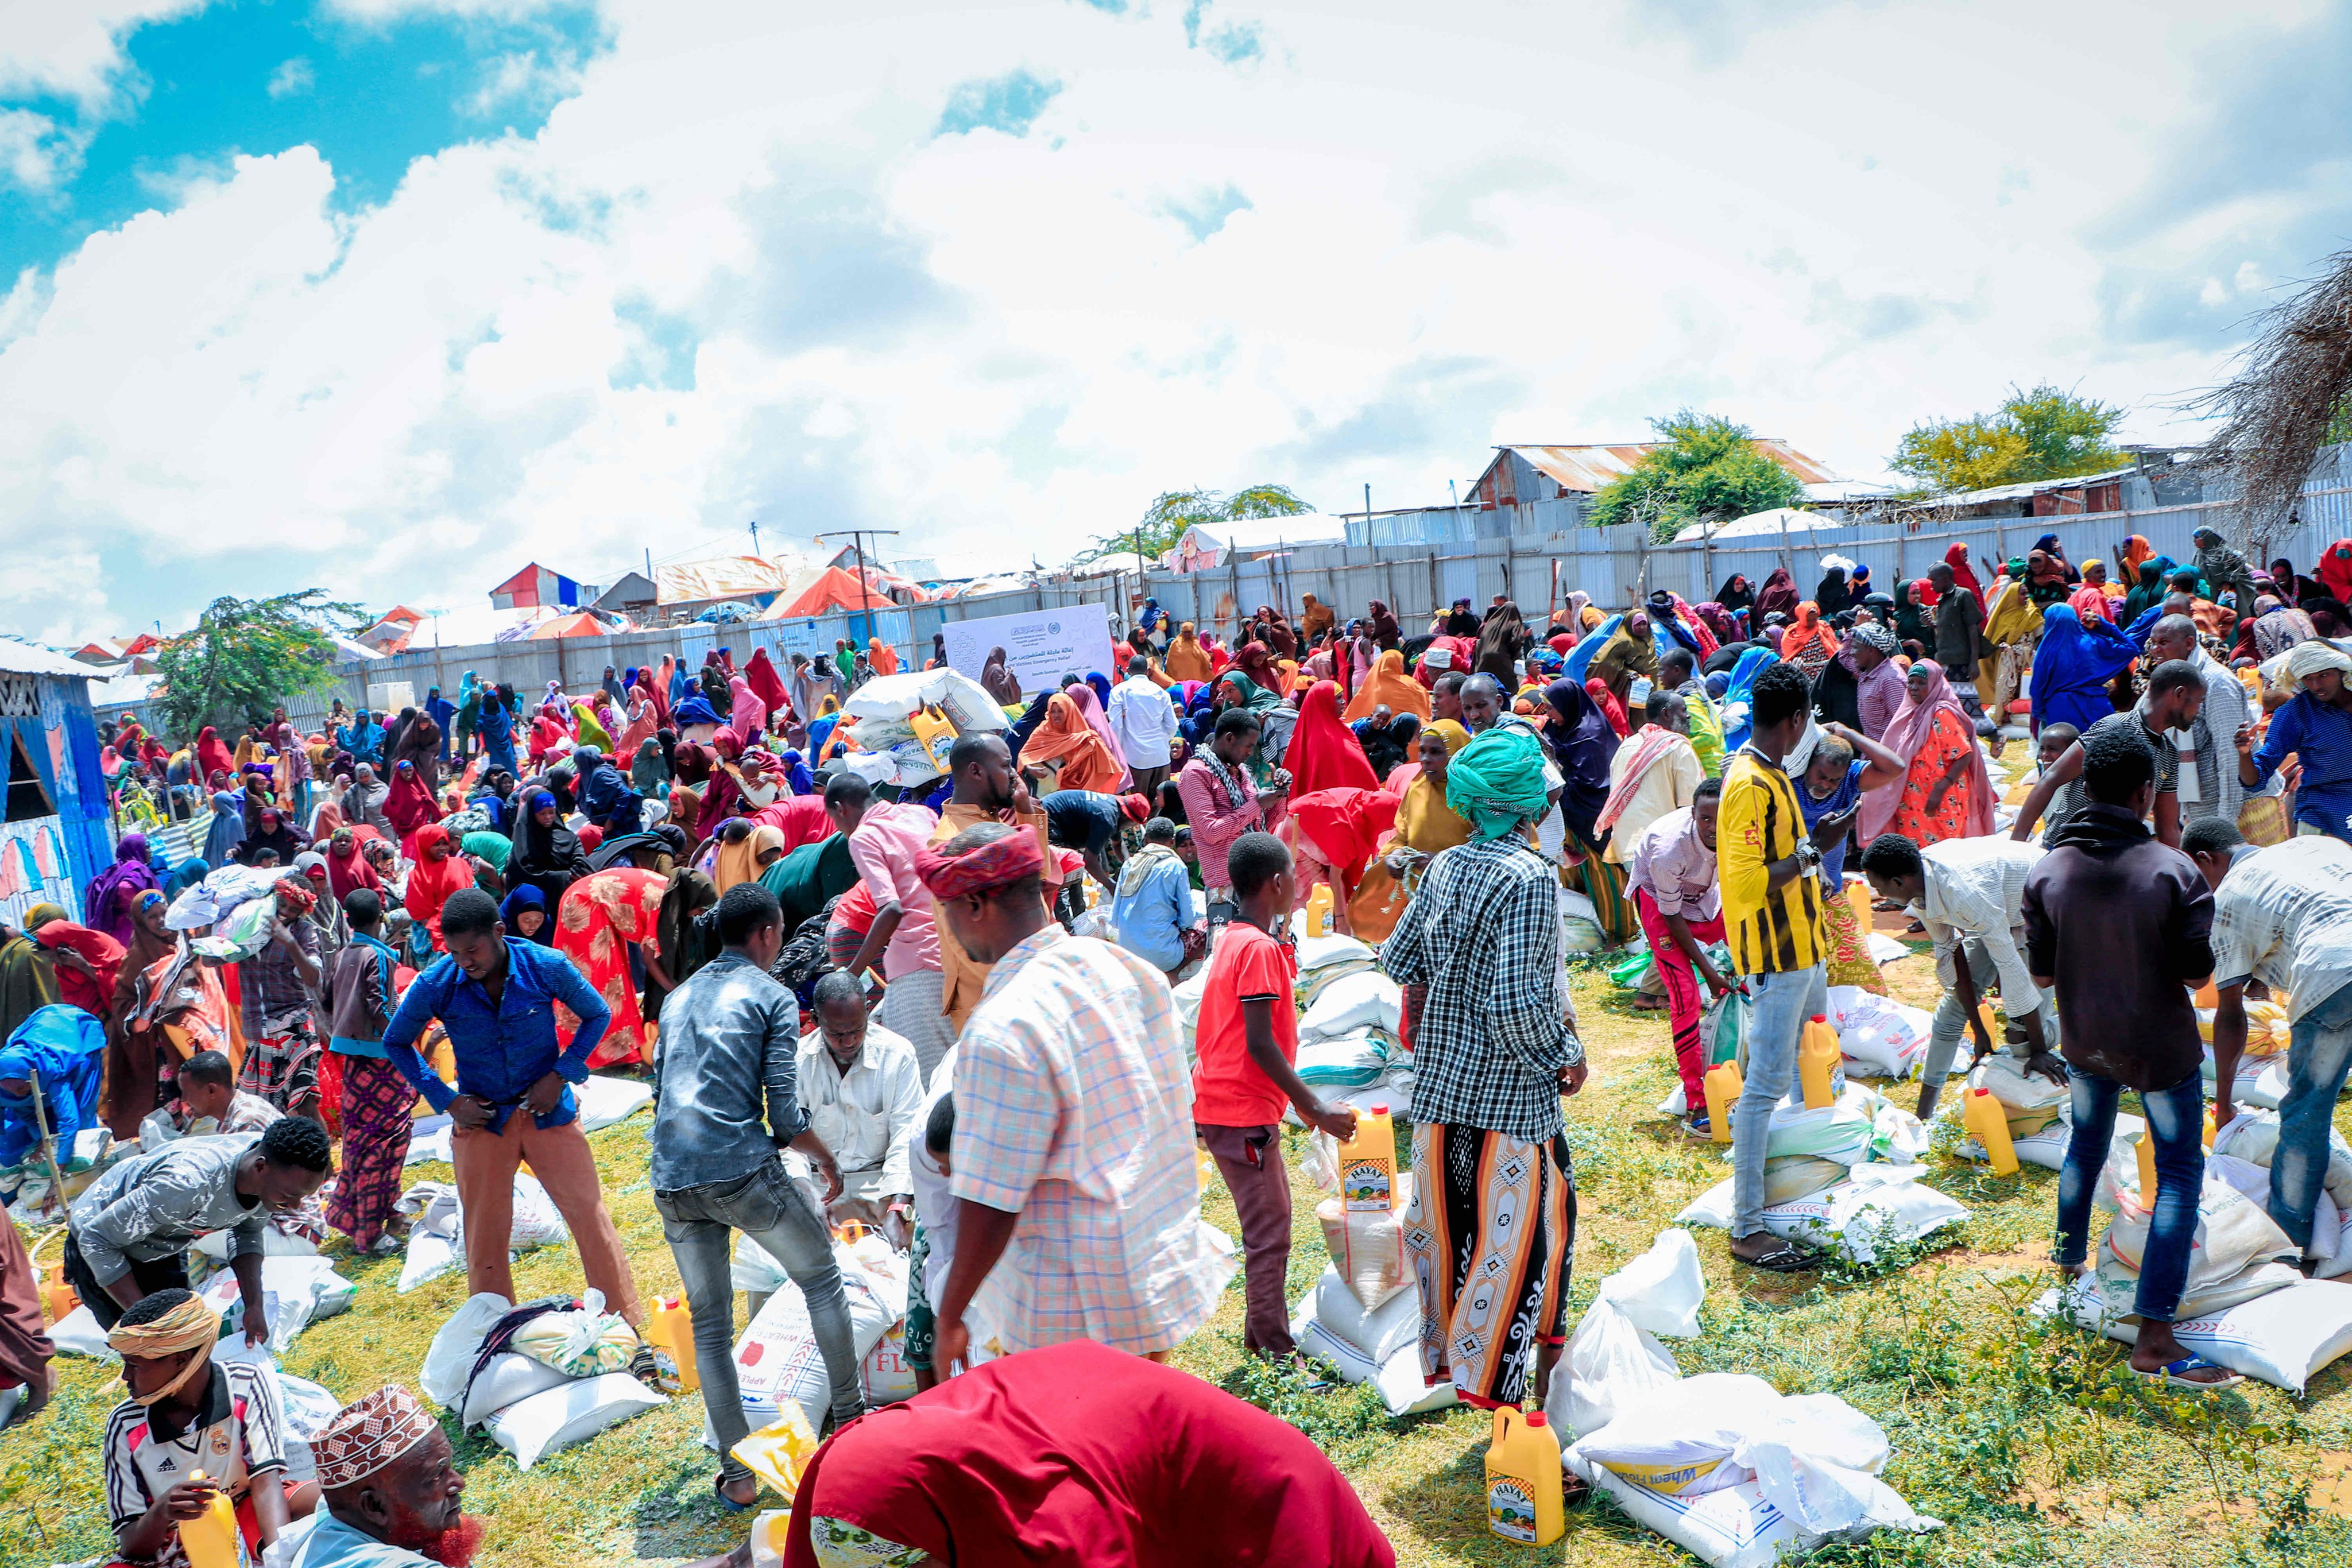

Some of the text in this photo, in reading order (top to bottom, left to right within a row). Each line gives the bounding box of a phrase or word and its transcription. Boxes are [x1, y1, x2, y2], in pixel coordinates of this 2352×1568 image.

[1019, 651, 1046, 660] للمتضررين
[1351, 1167, 1383, 1179] HAYAT
[741, 1374, 767, 1385] APPLE
[1649, 1467, 1696, 1485] Wheat
[1495, 1484, 1529, 1503] HAYAT
